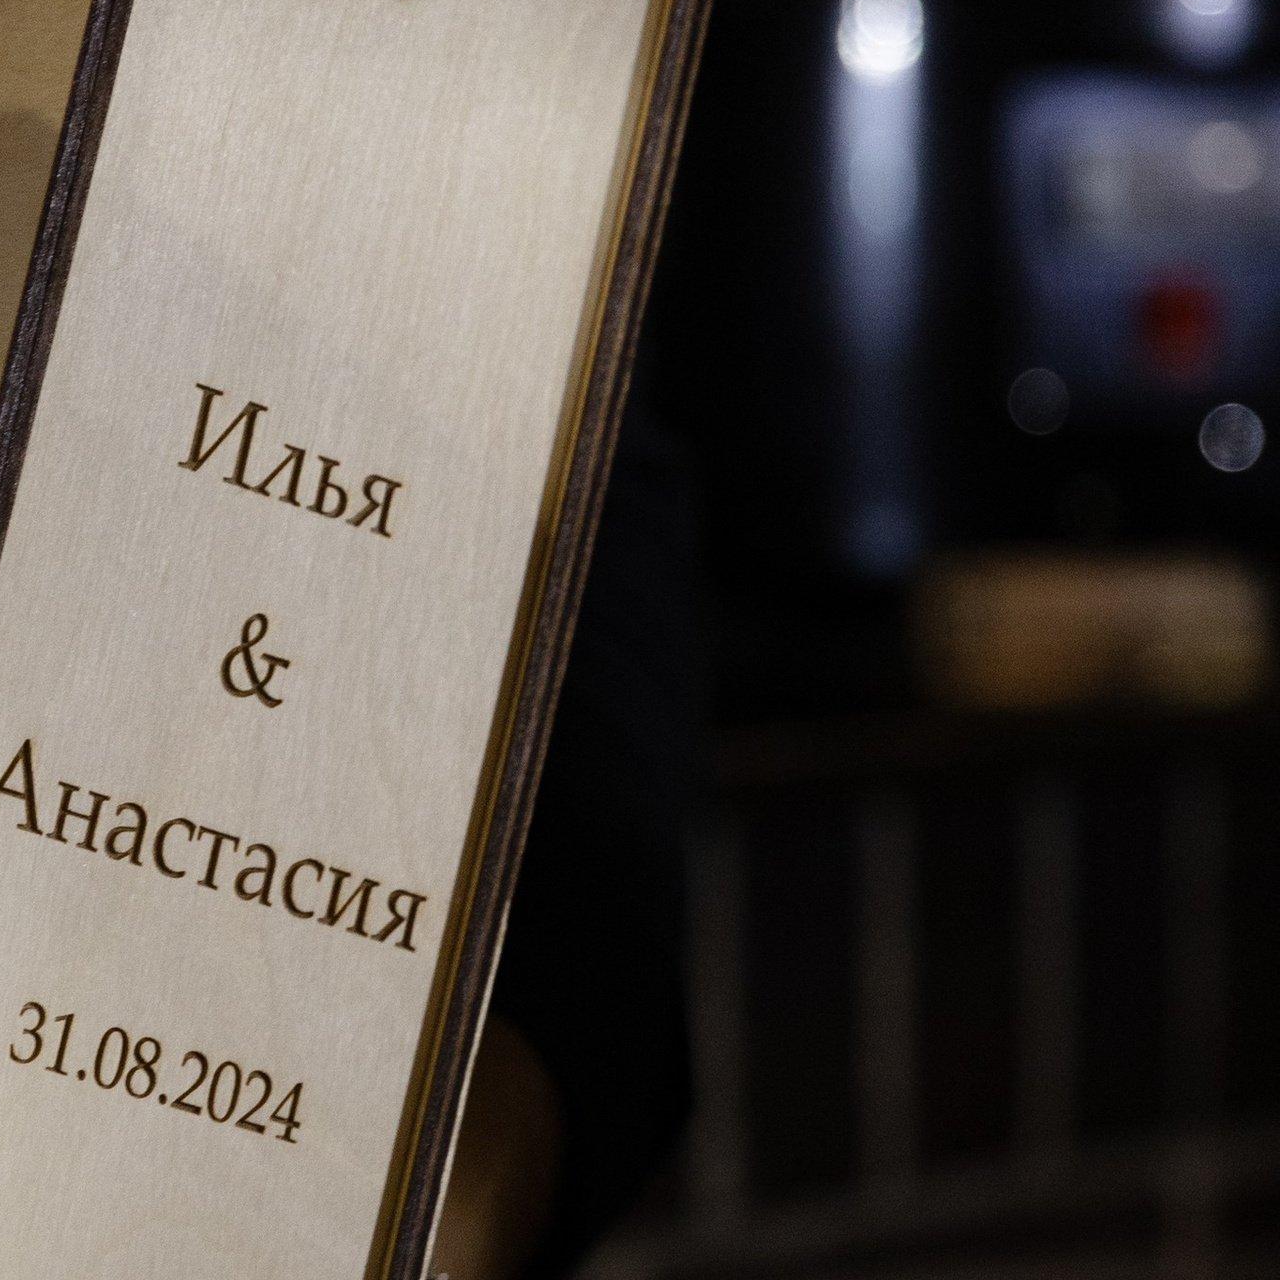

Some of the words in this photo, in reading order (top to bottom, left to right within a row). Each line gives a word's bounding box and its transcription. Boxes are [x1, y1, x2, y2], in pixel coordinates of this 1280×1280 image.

[177, 382, 403, 539] Илья
[220, 612, 291, 709] &
[9, 1001, 304, 1144] 31.08.2024
